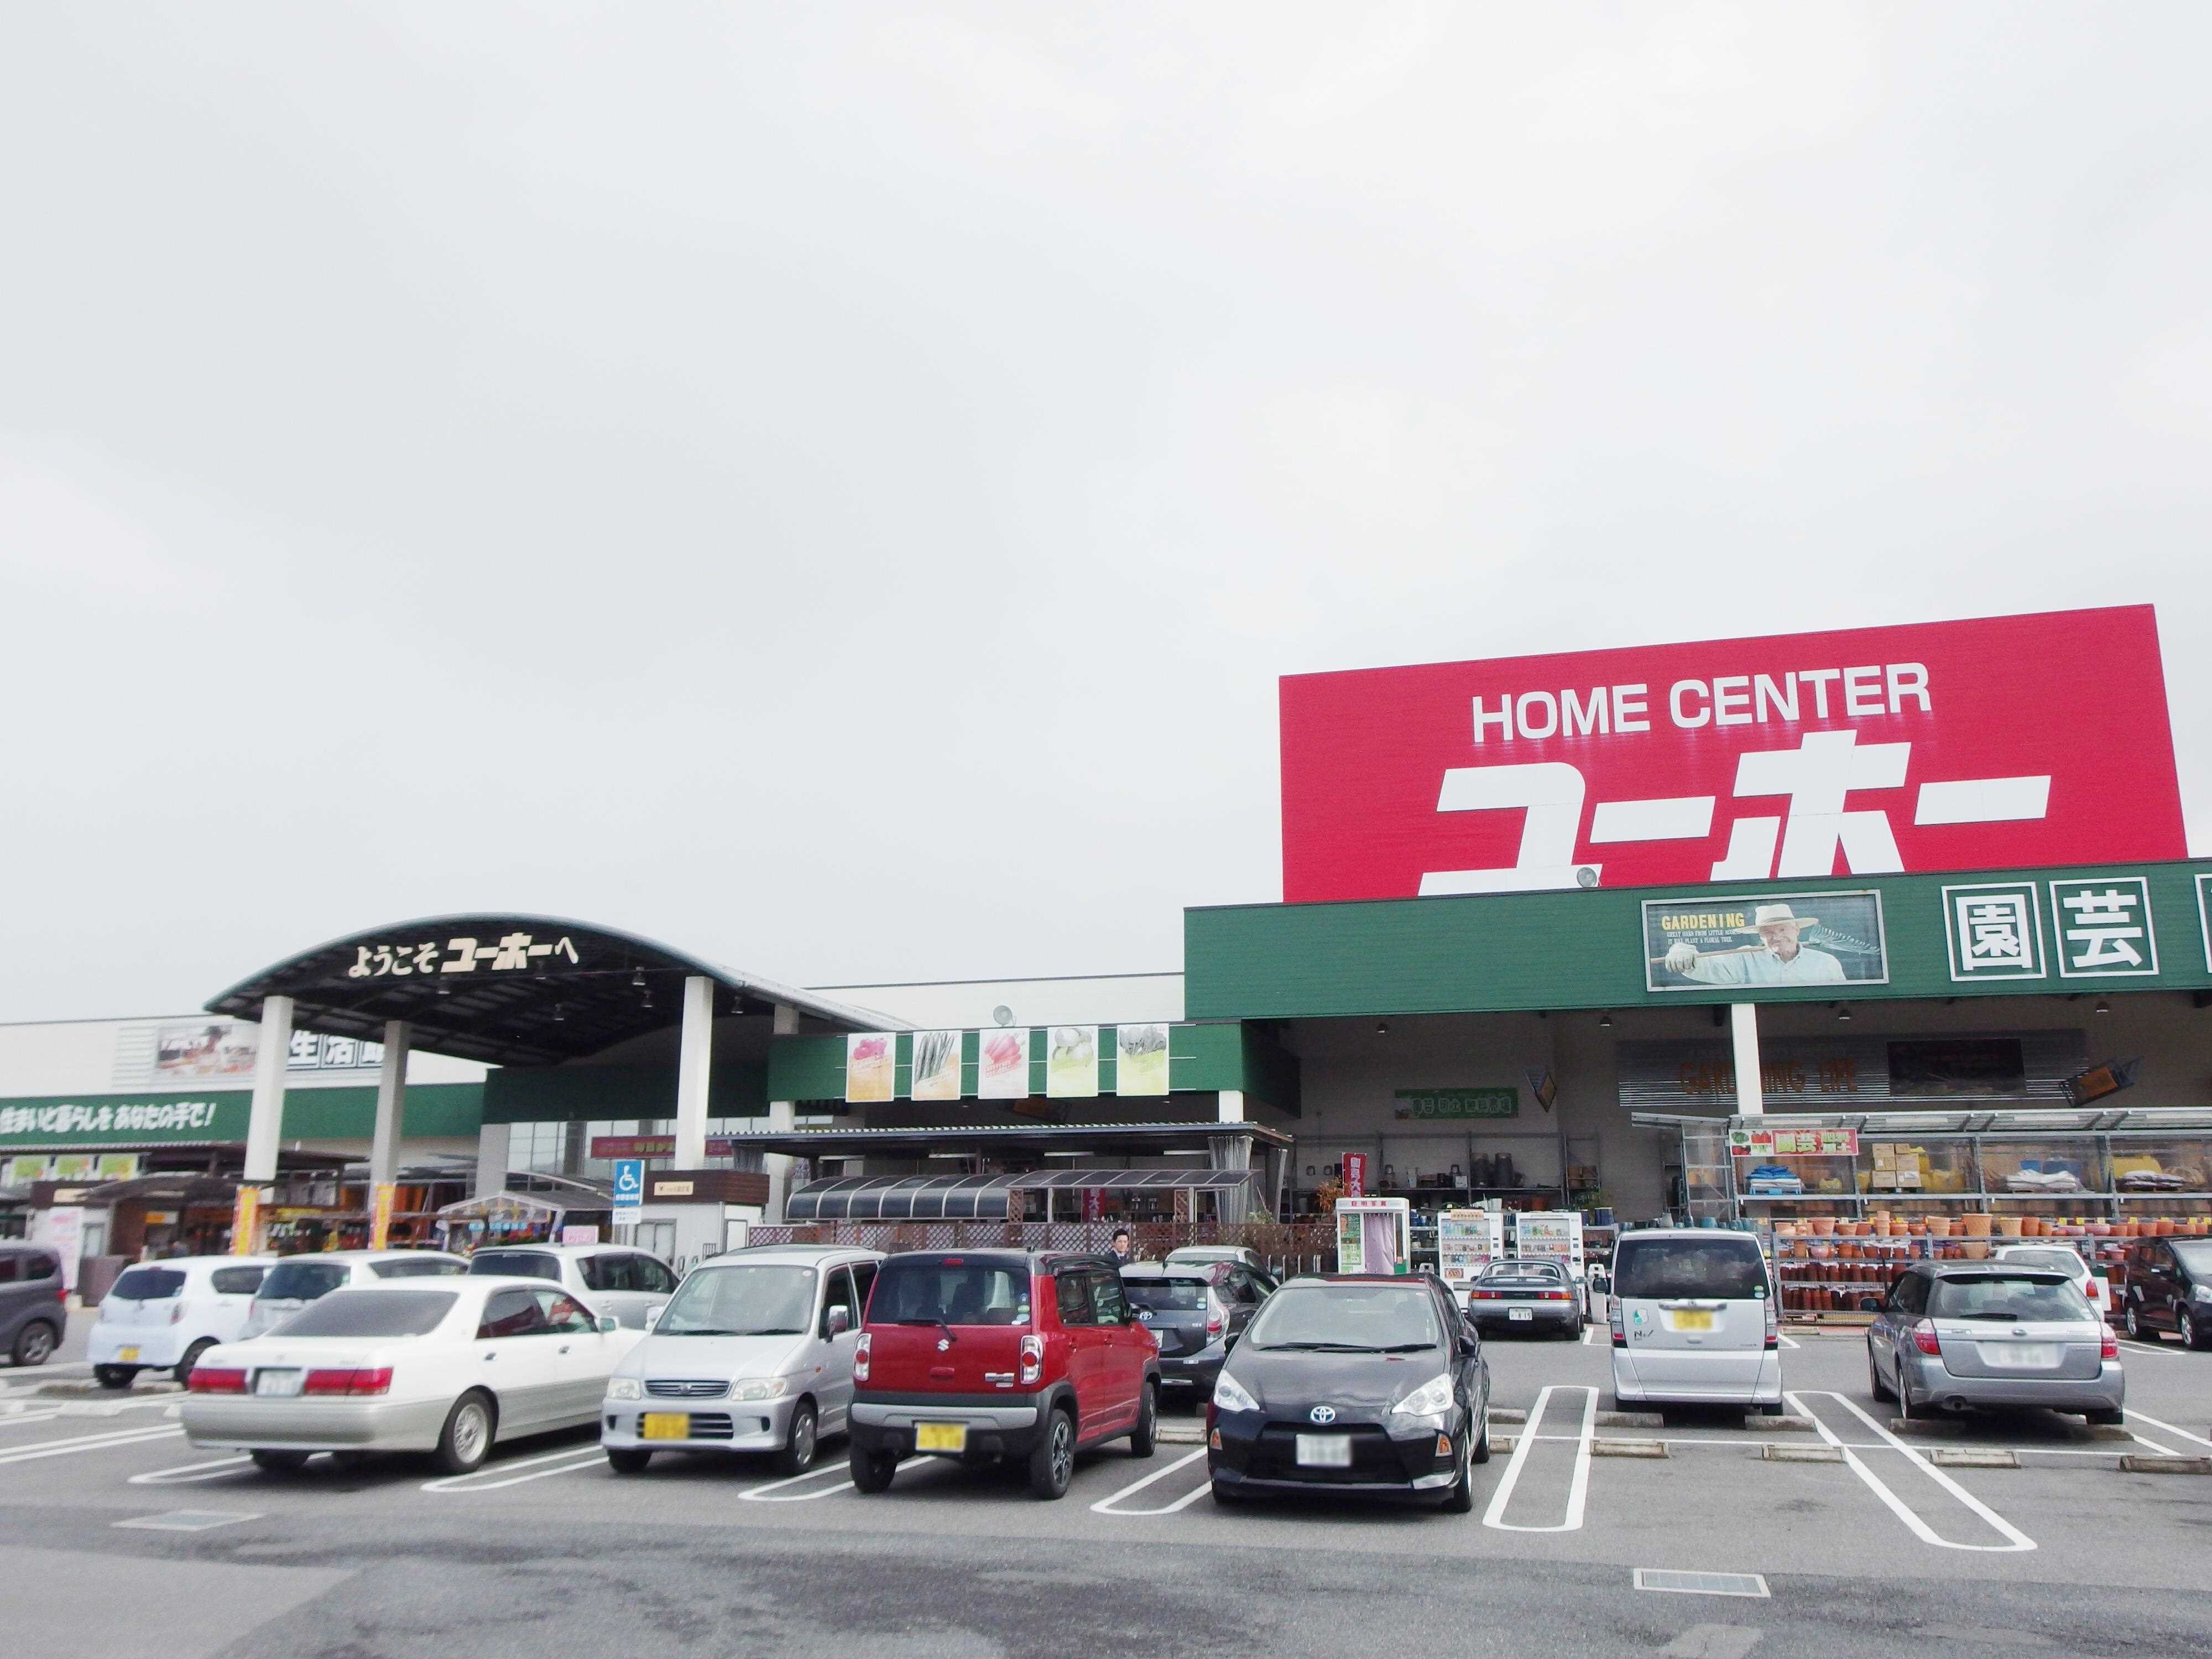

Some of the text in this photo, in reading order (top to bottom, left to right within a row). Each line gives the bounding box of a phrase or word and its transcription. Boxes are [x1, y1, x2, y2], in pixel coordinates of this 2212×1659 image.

[1472, 662, 1931, 744] HOME CENTER
[1417, 729, 2051, 896] ユーホー
[1661, 912, 1745, 930] GARDENING
[1955, 889, 2143, 971] 園芸
